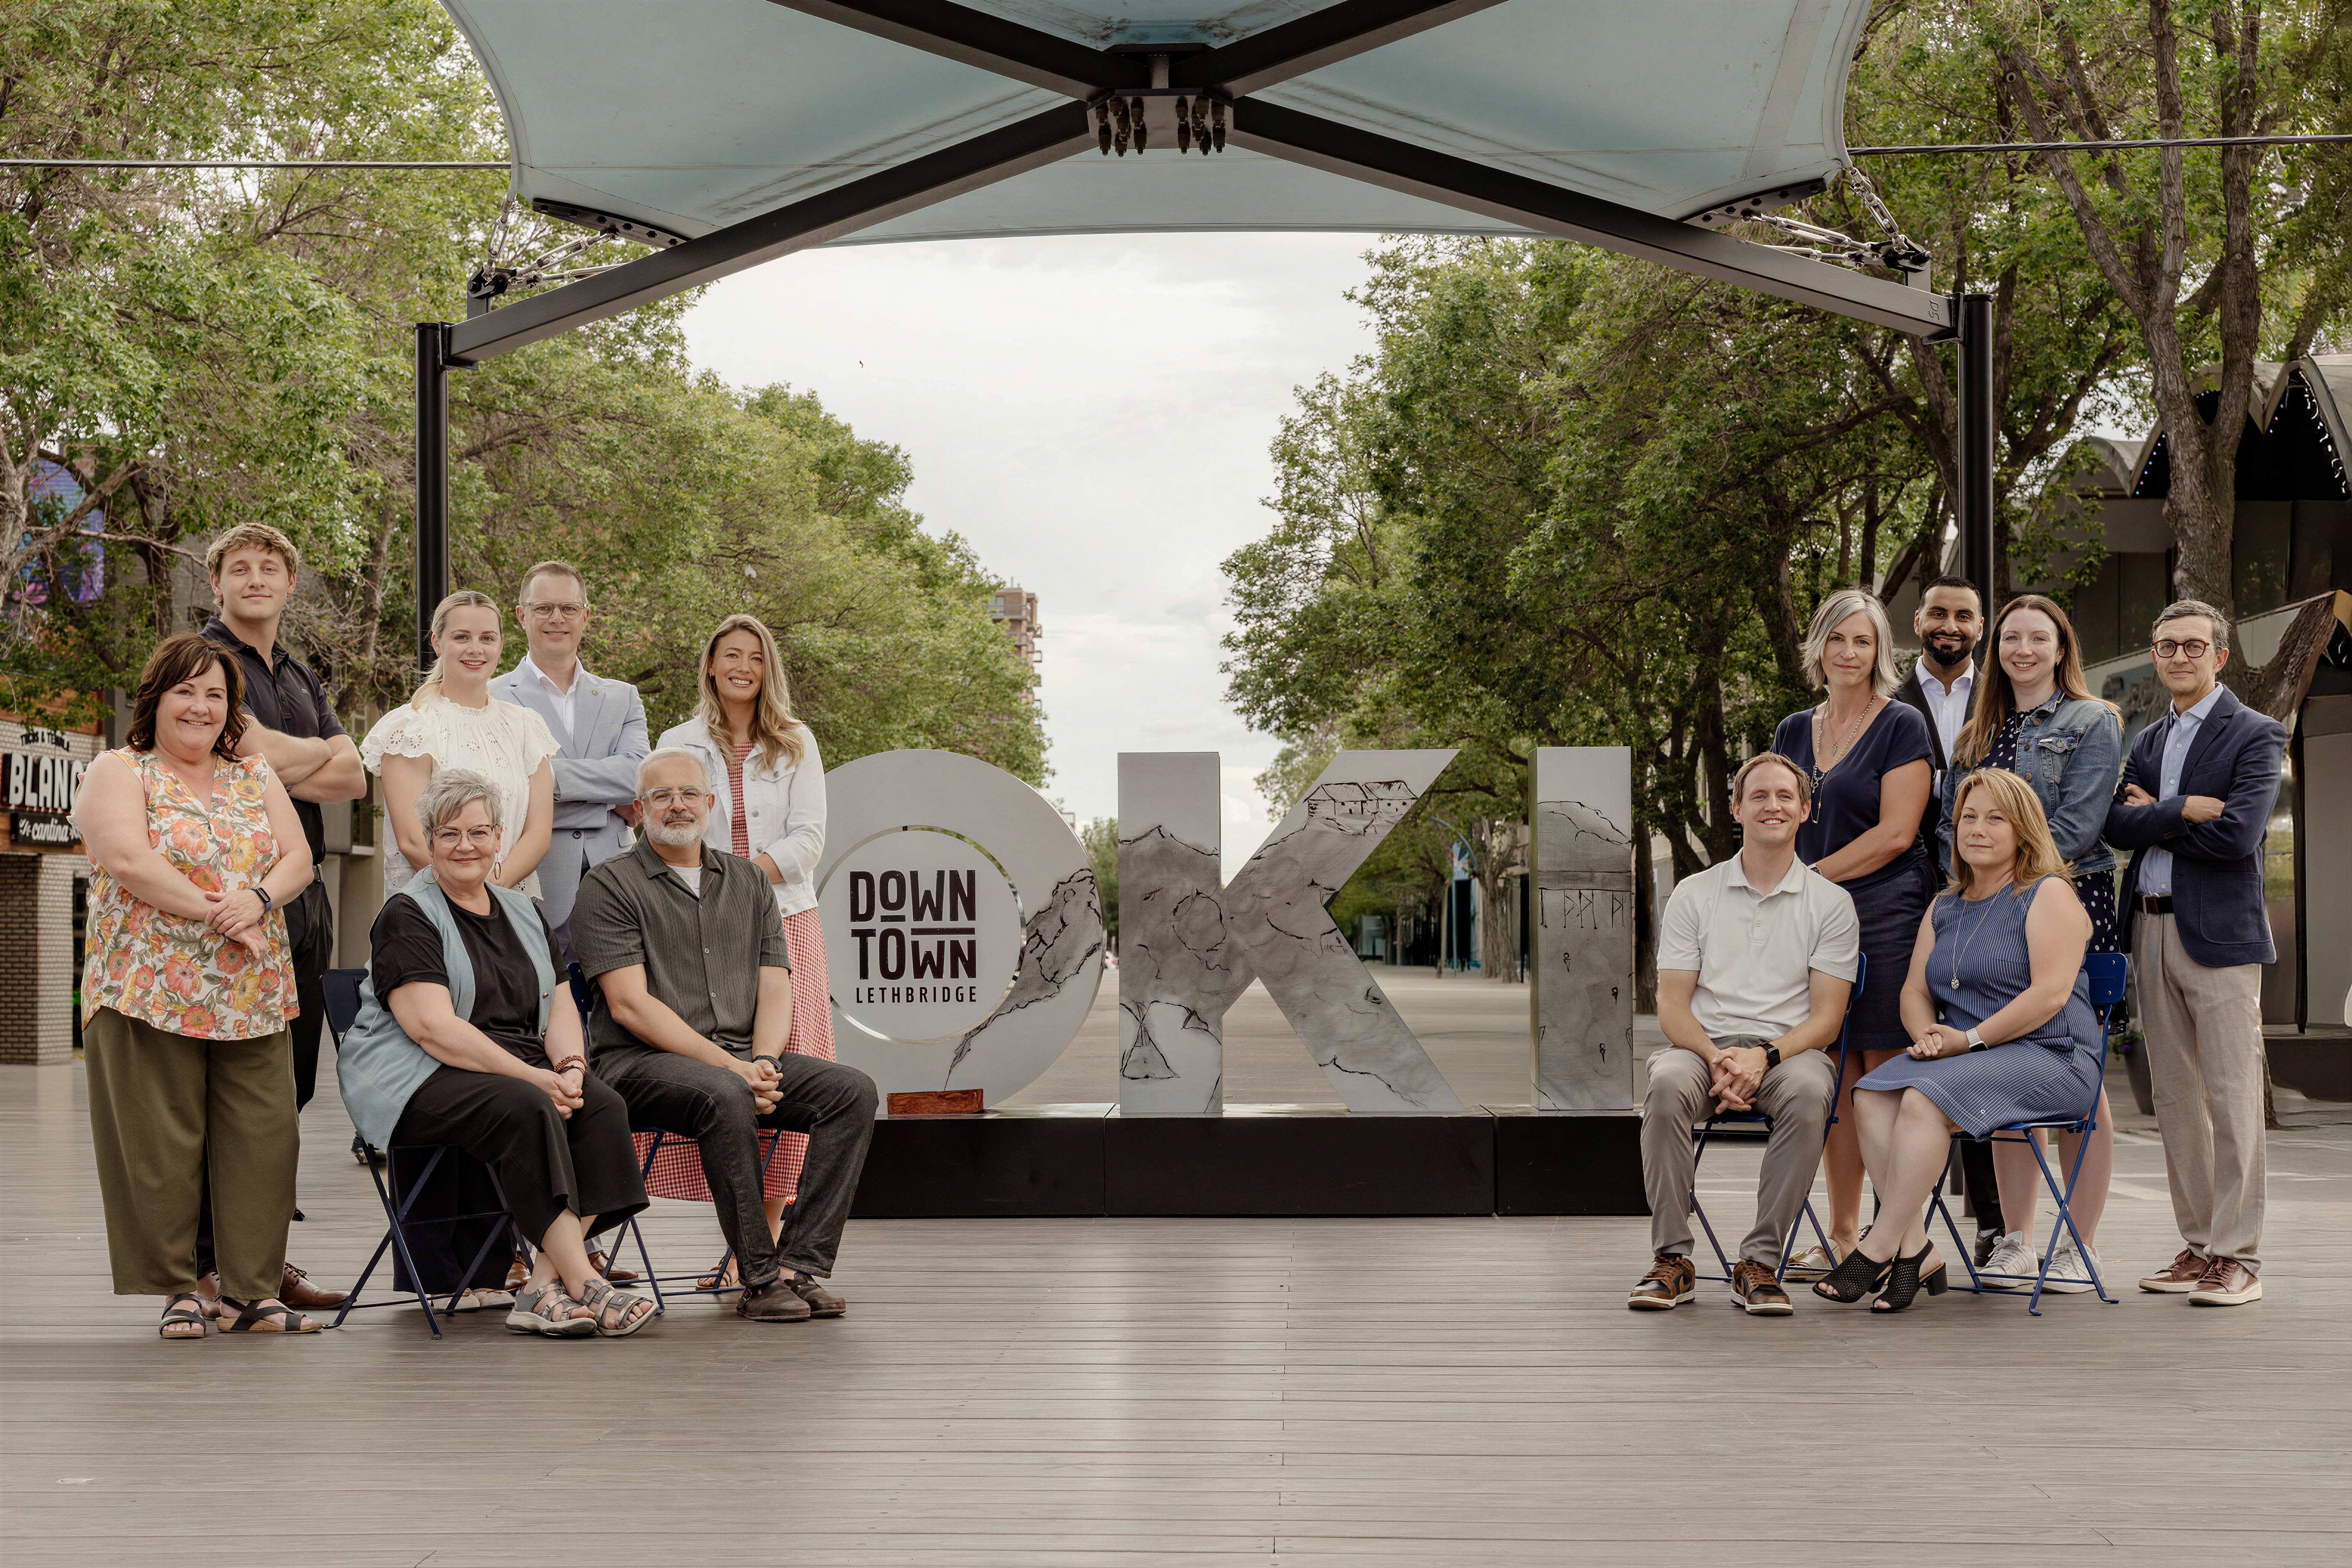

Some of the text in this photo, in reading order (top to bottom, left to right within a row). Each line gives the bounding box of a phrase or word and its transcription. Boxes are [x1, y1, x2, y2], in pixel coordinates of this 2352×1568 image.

[31, 817, 69, 842] cantina
[850, 869, 976, 922] DOWN
[851, 927, 977, 980] TOWN
[856, 986, 977, 1003] LETHBRIDGE
